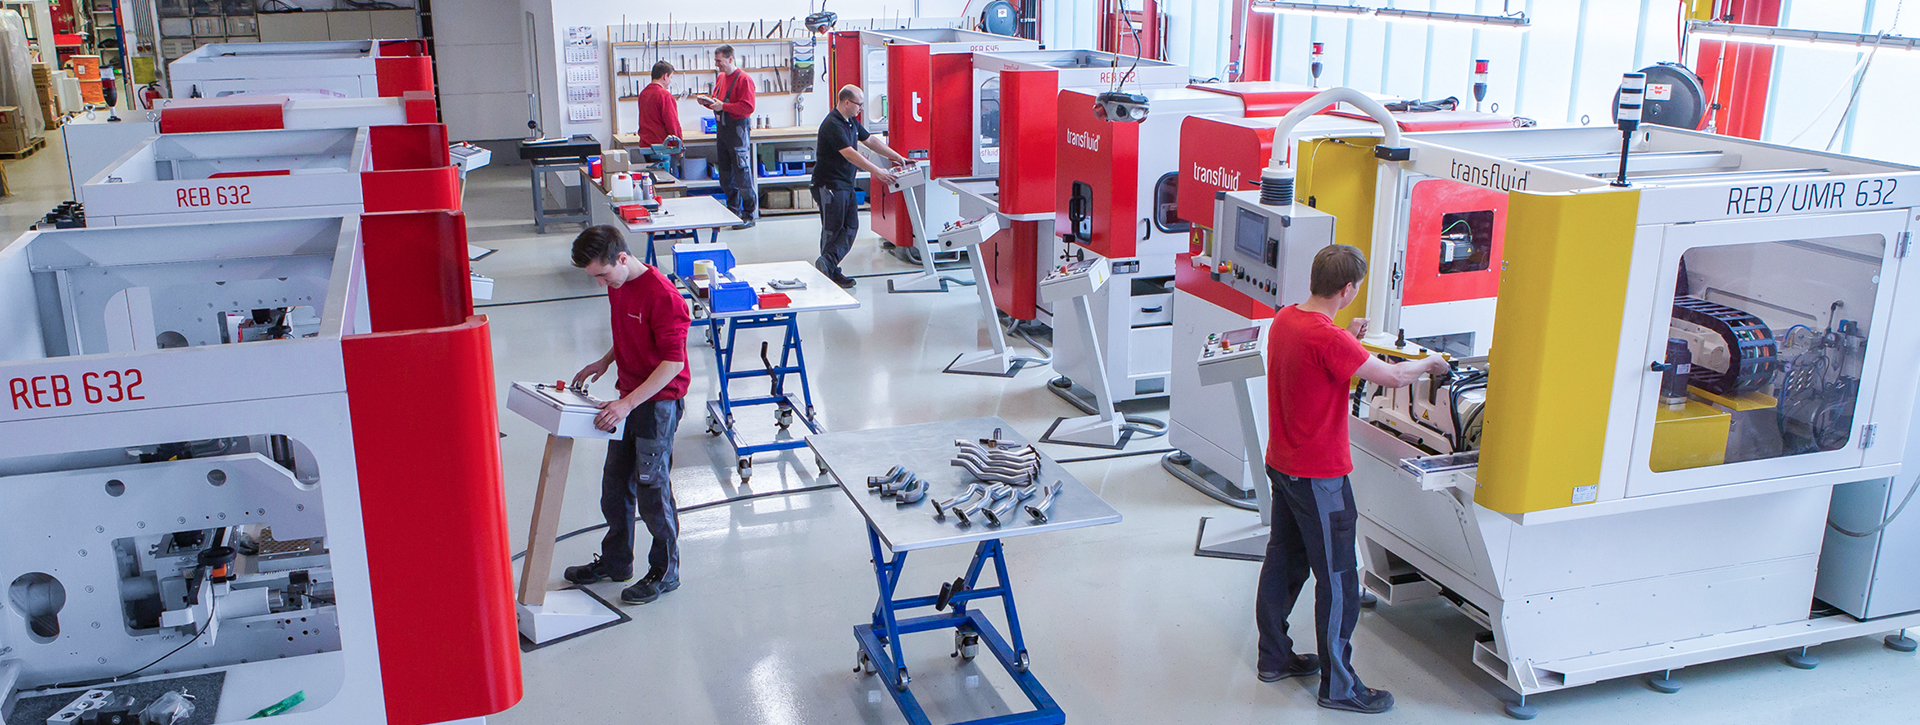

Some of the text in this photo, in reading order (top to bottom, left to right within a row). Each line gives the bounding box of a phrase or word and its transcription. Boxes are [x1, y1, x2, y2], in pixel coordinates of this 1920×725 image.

[1100, 71, 1136, 83] REB 632
[911, 91, 923, 122] t
[1066, 127, 1099, 152] transfluid
[1193, 161, 1239, 192] transfluid
[1450, 158, 1528, 192] transfluid
[176, 185, 252, 208] REB 632
[1855, 178, 1898, 207] 632
[9, 368, 146, 411] REB 632
